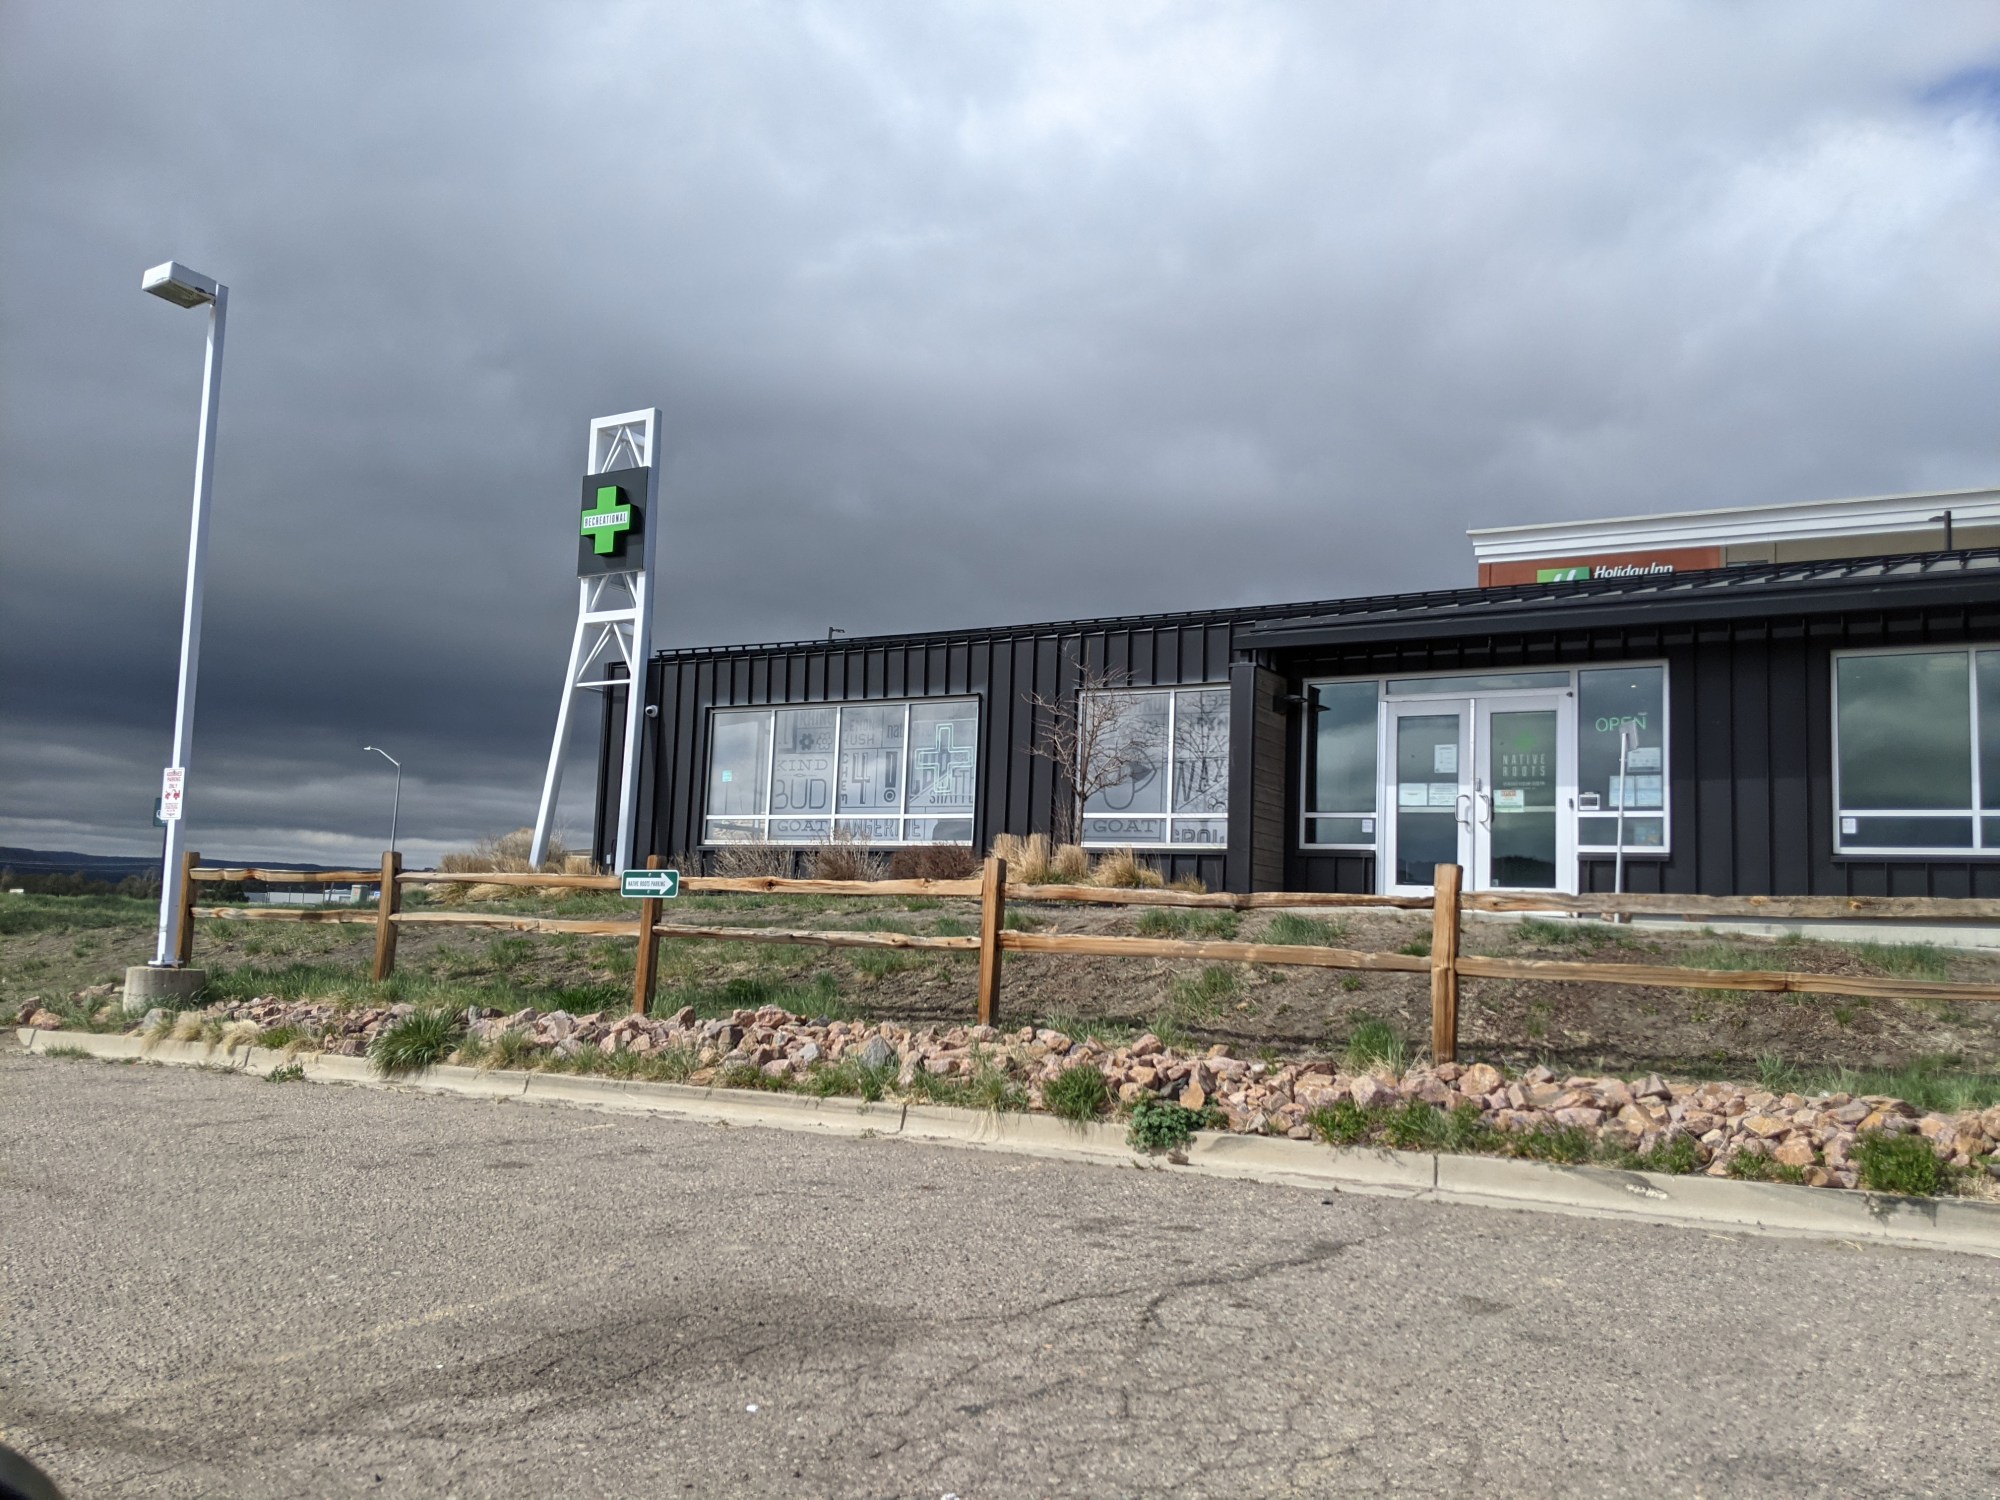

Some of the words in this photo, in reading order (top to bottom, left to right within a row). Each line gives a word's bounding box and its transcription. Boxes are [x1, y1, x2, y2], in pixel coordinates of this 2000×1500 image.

[584, 512, 627, 527] RECREATIONAL
[1594, 564, 1649, 579] Holiday
[1650, 562, 1674, 574] Inn
[777, 759, 828, 771] KIND
[1502, 753, 1546, 765] NATIVE
[1502, 765, 1546, 777] ROOTS
[774, 778, 827, 809] BUD
[777, 820, 828, 832] GOAT
[1093, 819, 1157, 833] GOAT
